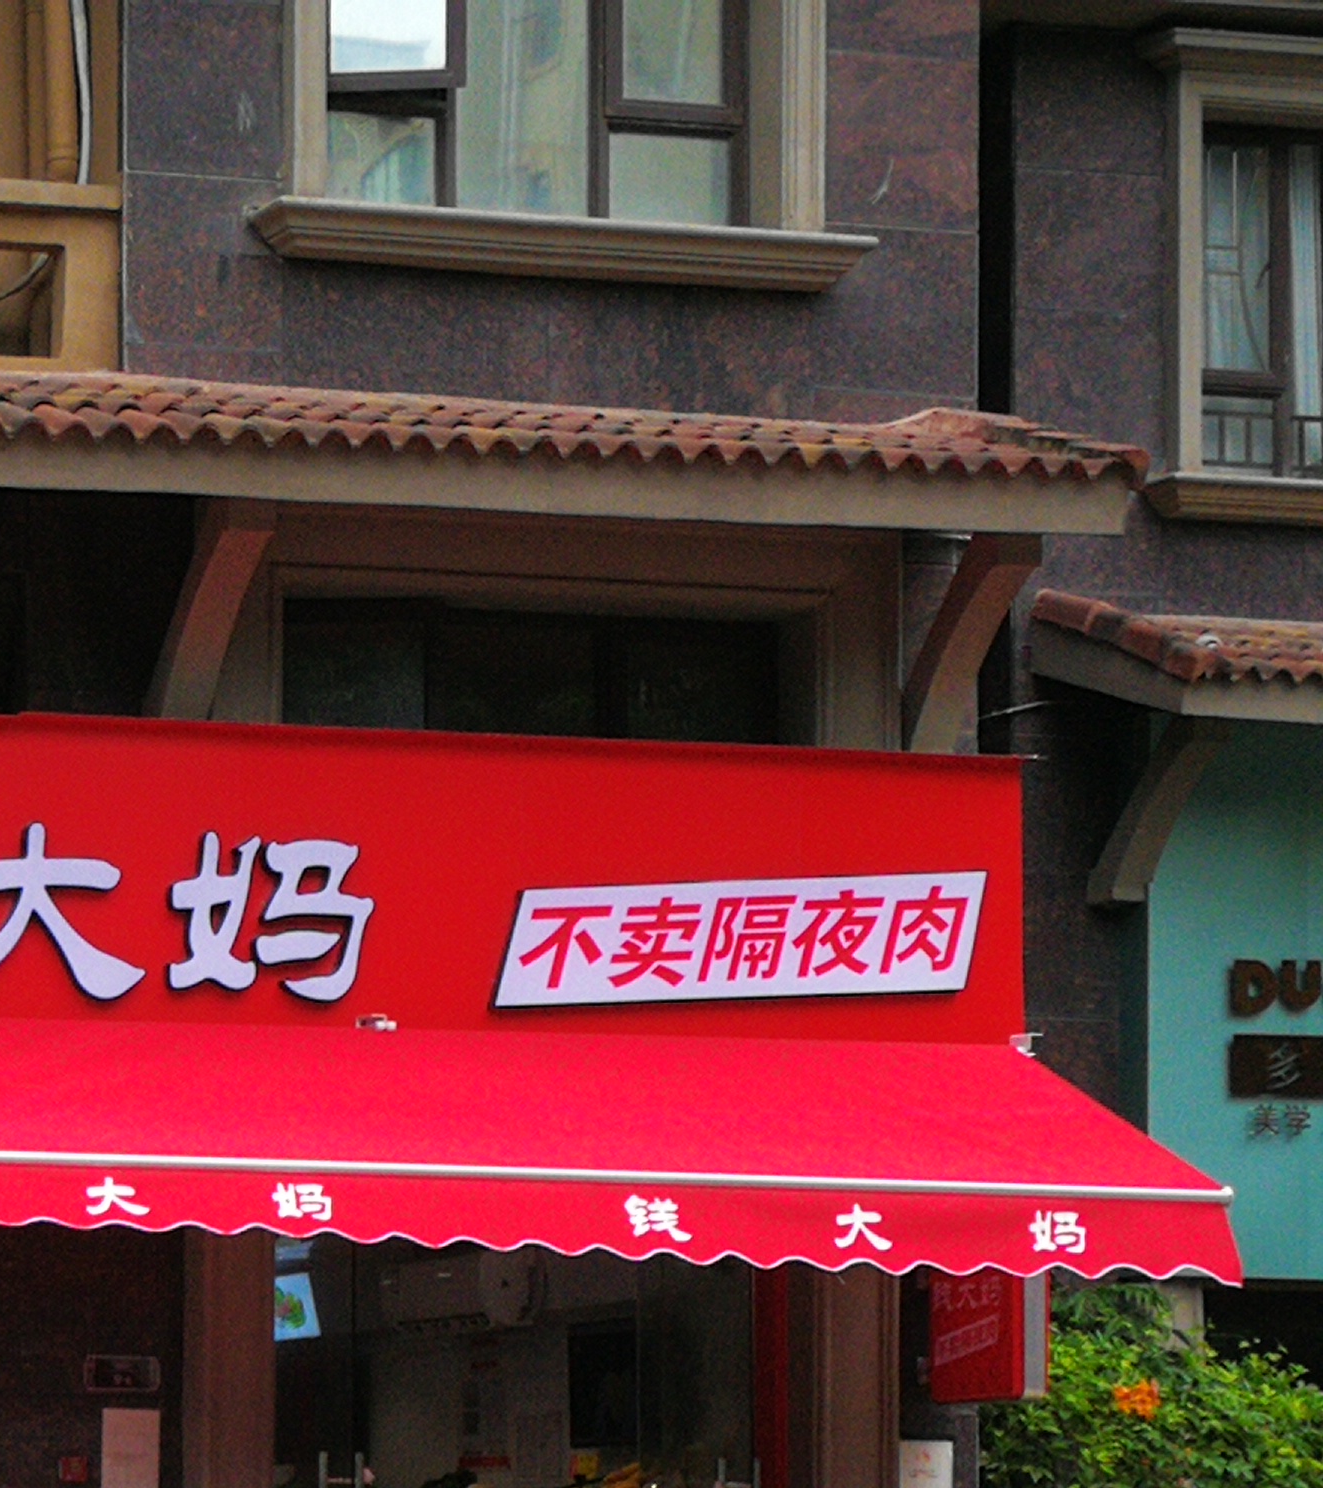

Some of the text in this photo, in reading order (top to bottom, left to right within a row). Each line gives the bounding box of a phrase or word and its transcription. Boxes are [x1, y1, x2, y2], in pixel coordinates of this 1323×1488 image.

[519, 884, 970, 990] 不卖隔夜肉
[1253, 1104, 1312, 1136] 美学
[625, 1194, 1088, 1255] 钱大妈
